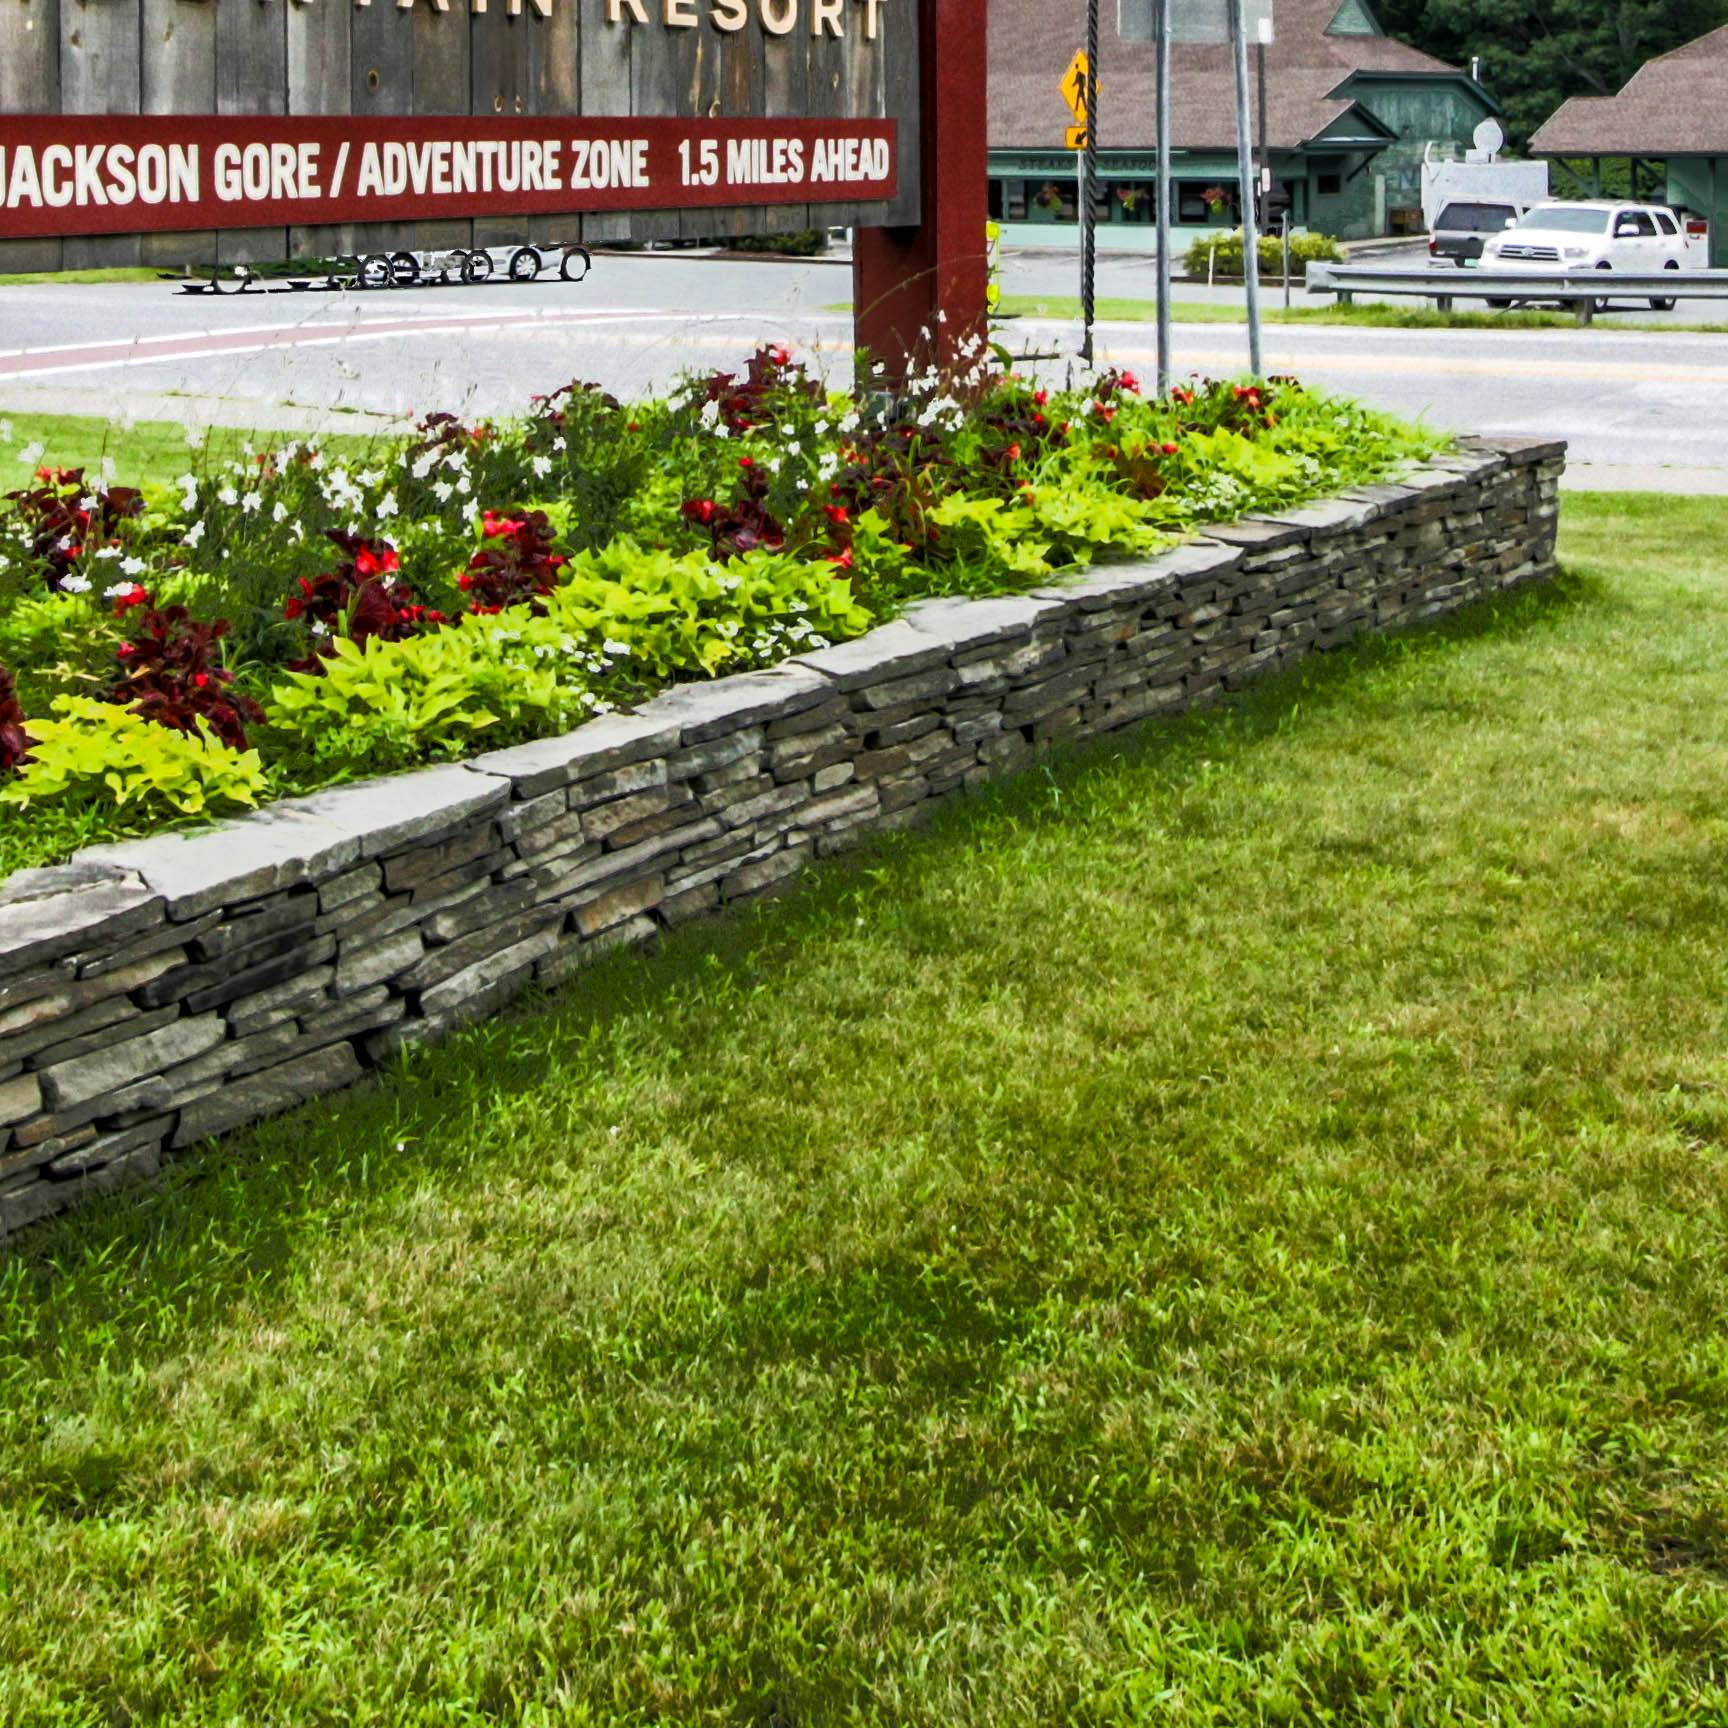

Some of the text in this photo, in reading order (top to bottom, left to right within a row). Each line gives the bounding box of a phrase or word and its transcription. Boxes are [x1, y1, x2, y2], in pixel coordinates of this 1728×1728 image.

[214, 142, 321, 201] GORE
[357, 140, 562, 197] ADVENTURE
[571, 139, 649, 189] ZONE
[678, 138, 719, 186] 1.5
[726, 138, 804, 185] MILES
[809, 137, 890, 183] AHEAD
